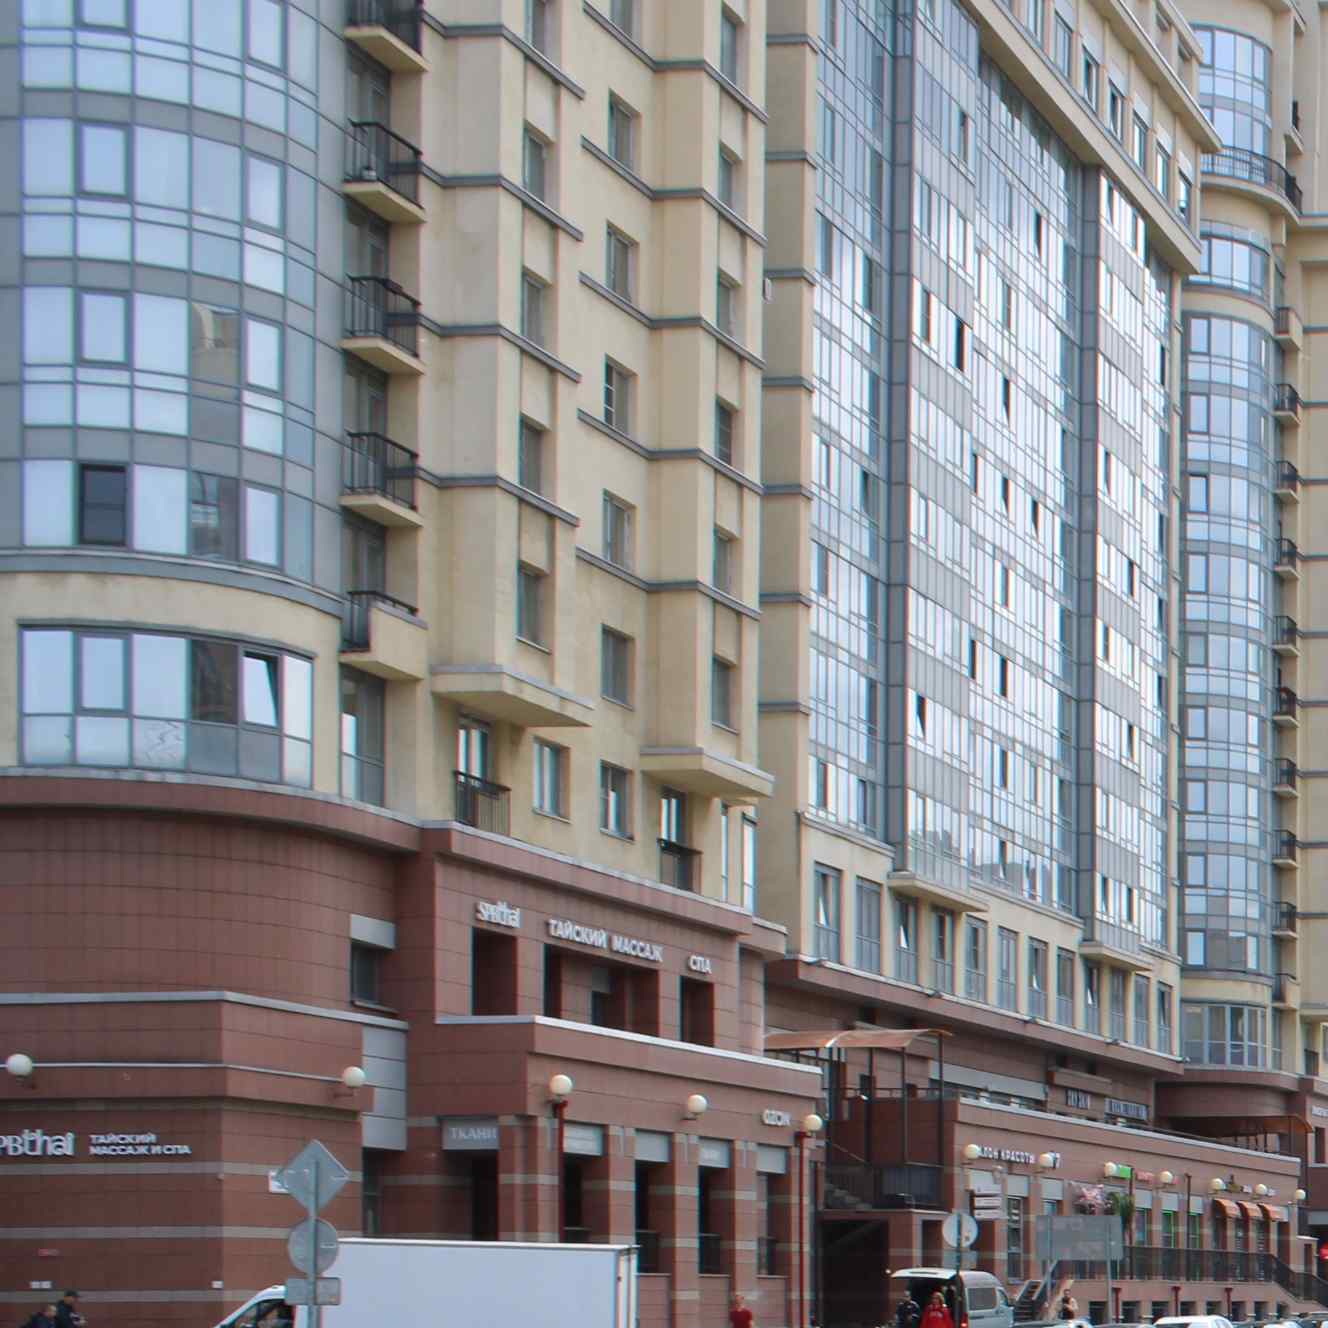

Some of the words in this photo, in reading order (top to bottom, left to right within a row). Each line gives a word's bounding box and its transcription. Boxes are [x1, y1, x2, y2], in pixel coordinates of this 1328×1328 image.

[549, 918, 608, 949] ТАЙСКИЙ
[612, 936, 664, 963] МАССАЖ
[688, 954, 713, 975] СПА
[89, 1132, 157, 1144] ТАЙСКИЙ
[450, 1127, 497, 1140] ТКАНИ
[0, 1129, 75, 1156] PBthai
[89, 1145, 149, 1156] МАССАЖ
[163, 1145, 193, 1155] СПА
